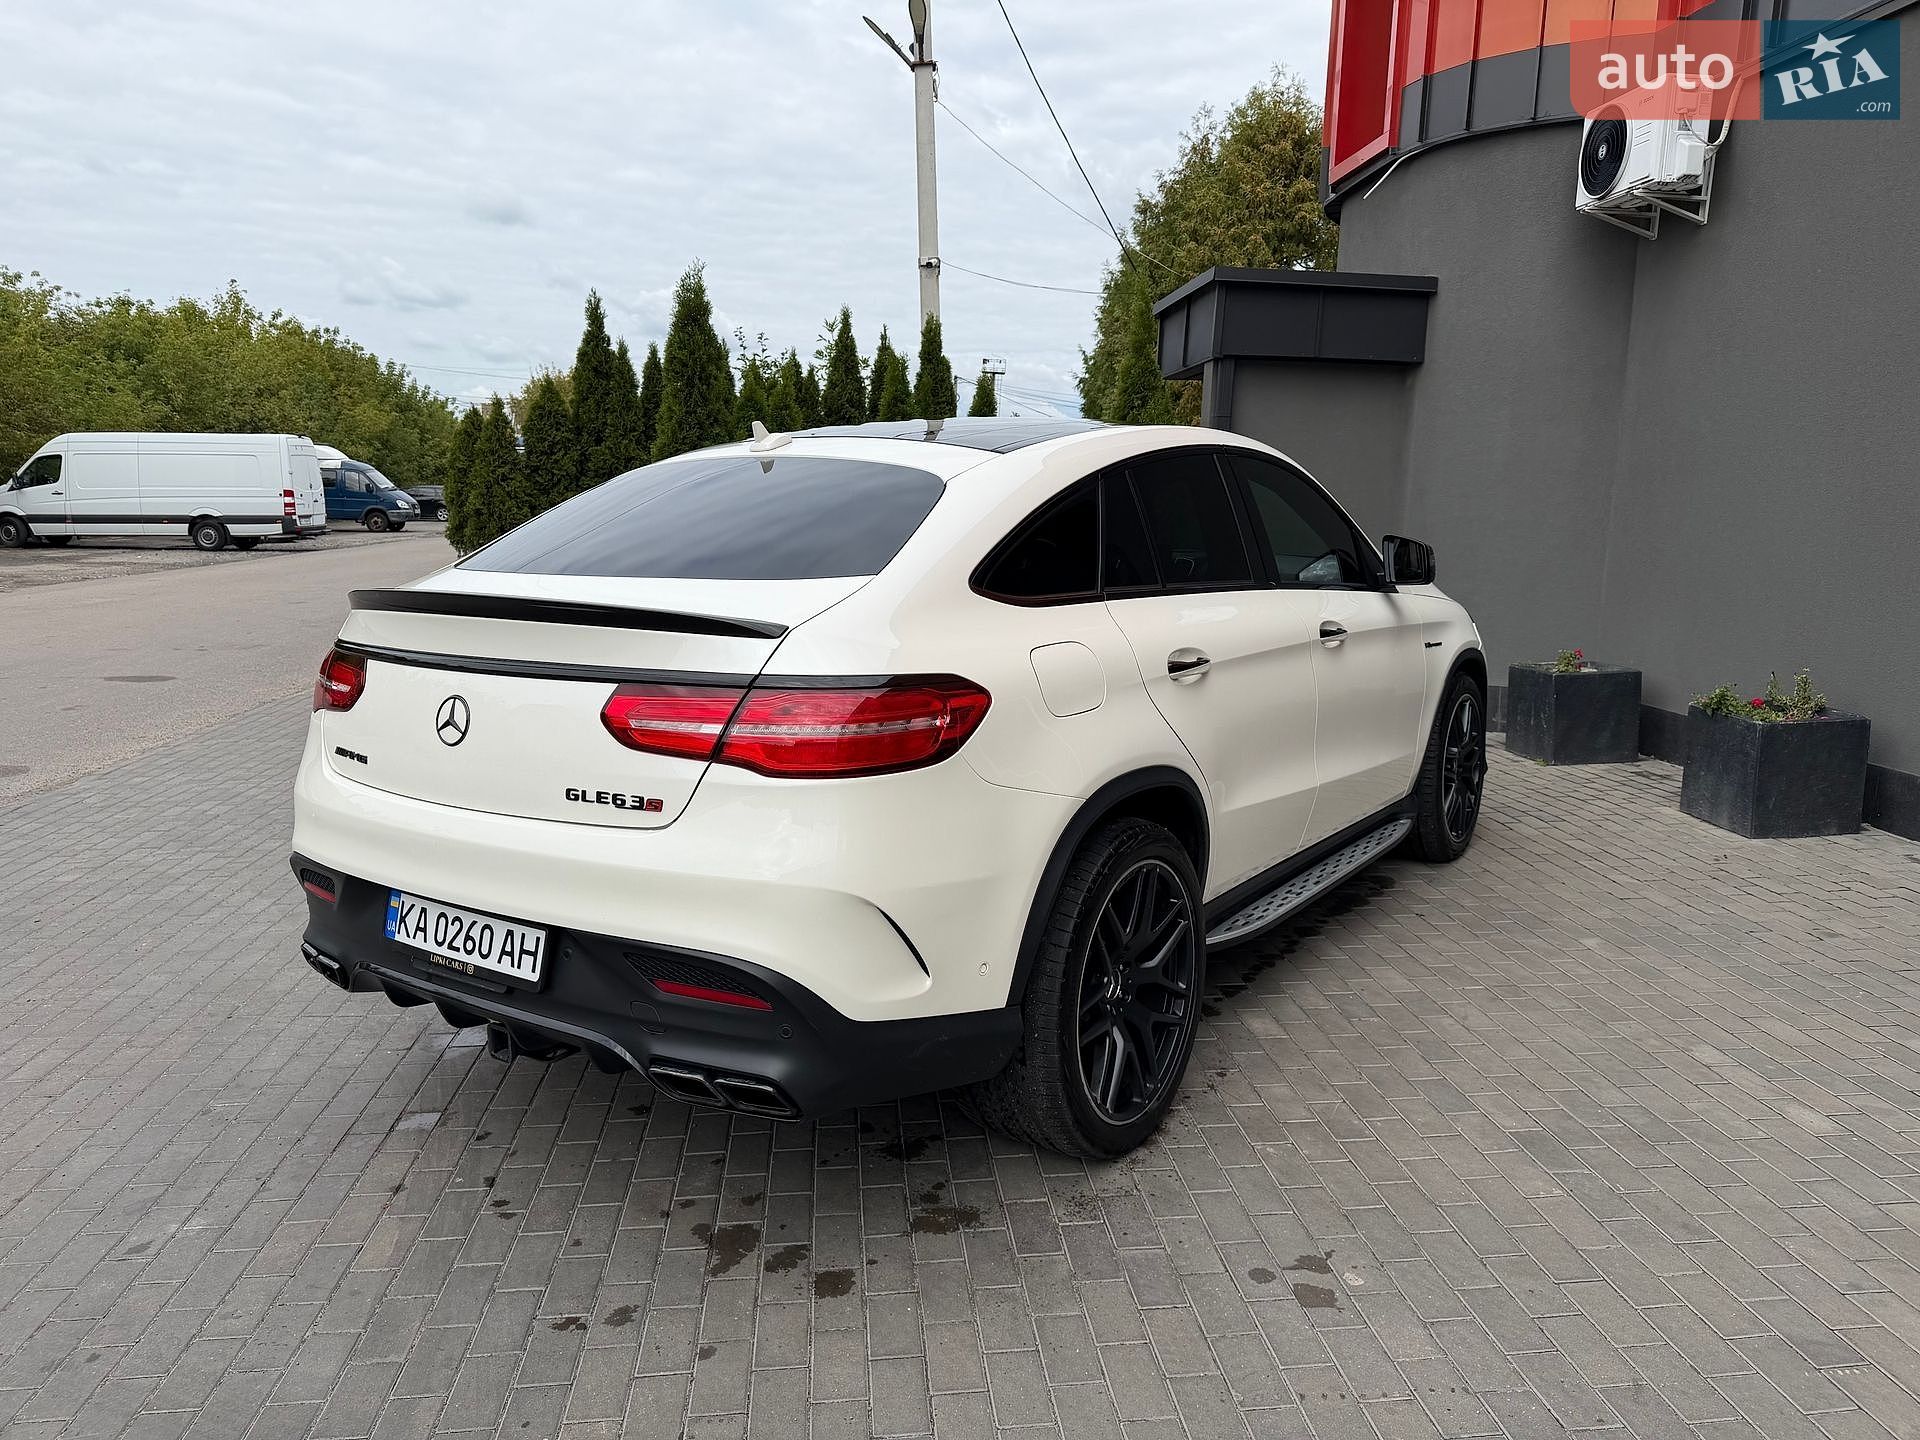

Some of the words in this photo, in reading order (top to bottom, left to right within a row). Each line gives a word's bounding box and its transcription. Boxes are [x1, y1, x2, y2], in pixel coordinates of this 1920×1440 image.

[386, 919, 396, 932] UA
[397, 900, 428, 944] KA
[433, 911, 495, 960] 0260
[497, 929, 541, 974] AH
